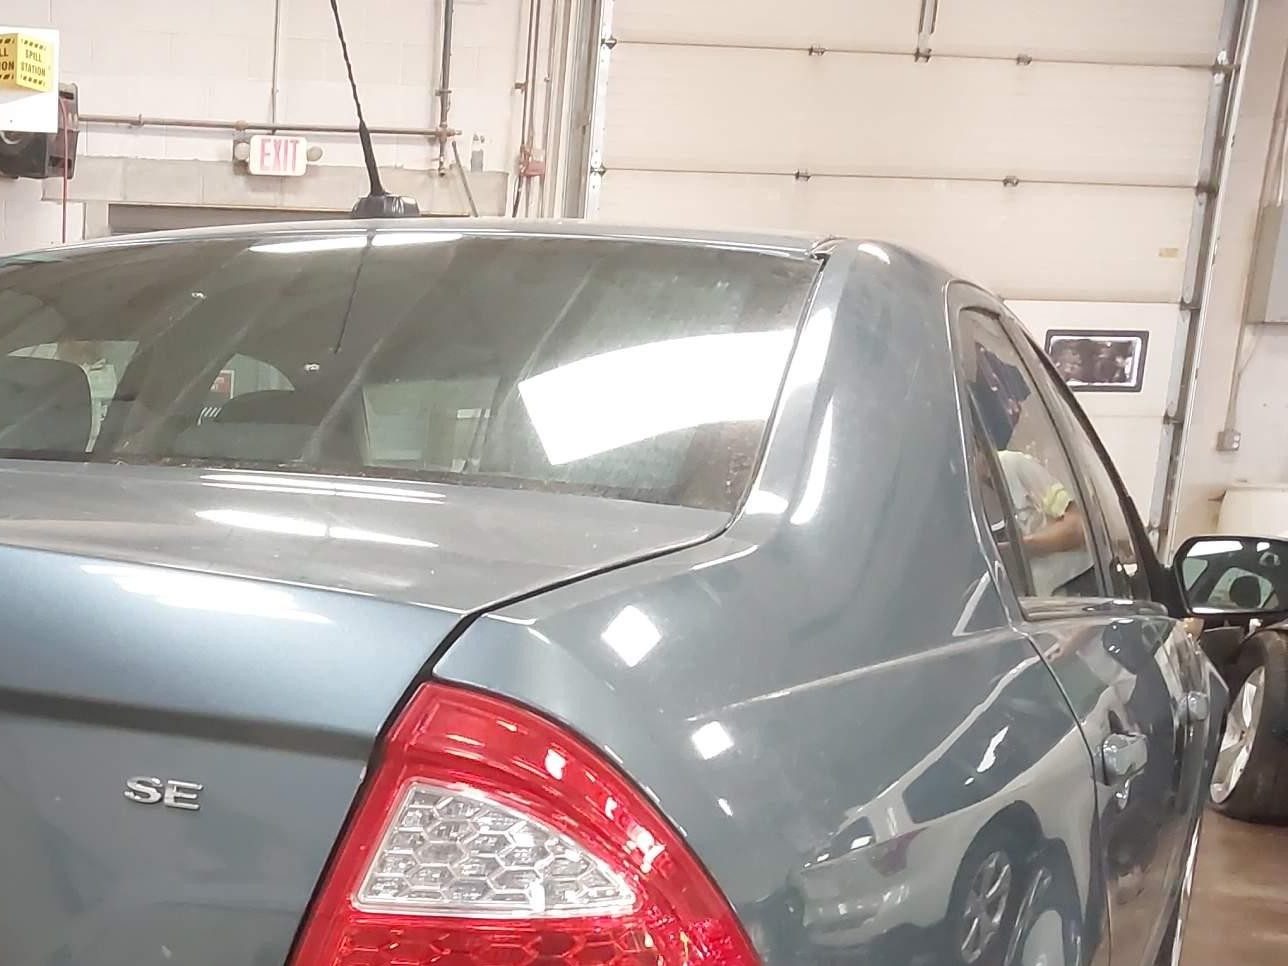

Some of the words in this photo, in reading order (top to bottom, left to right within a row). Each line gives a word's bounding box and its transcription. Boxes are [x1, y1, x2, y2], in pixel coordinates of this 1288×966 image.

[25, 49, 42, 63] SPILL
[20, 61, 46, 77] STATION
[259, 138, 300, 172] EXIT
[123, 775, 203, 811] SE
